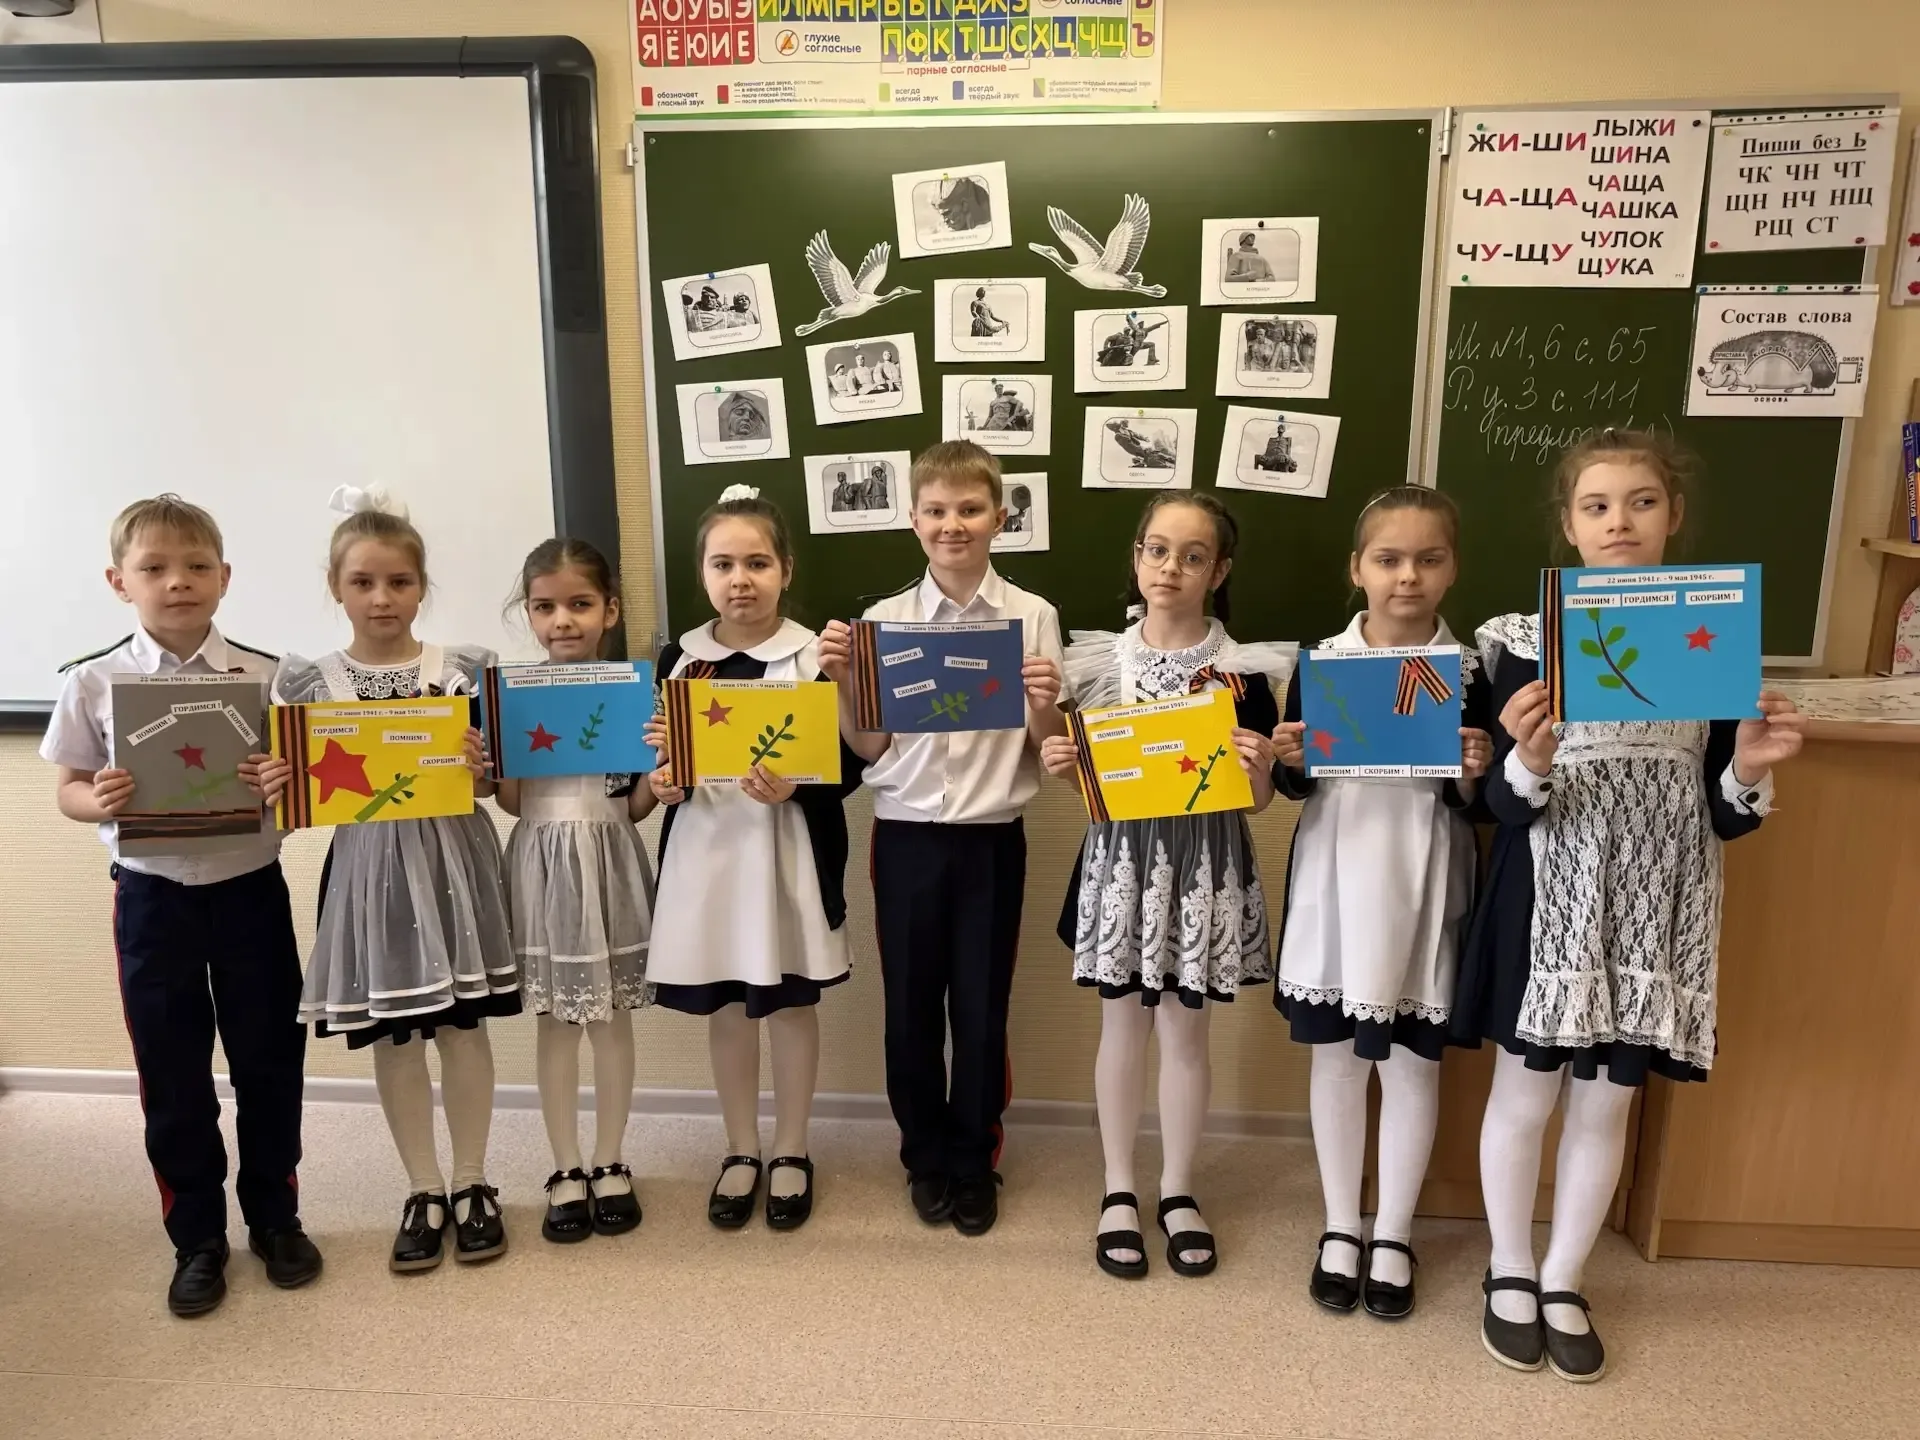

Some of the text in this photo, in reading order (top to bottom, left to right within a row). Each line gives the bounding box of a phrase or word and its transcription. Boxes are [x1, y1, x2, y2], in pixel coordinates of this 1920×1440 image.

[804, 34, 840, 44] глухие
[804, 44, 861, 53] согласные
[907, 64, 1007, 77] парные согласные
[657, 98, 687, 106] гласный
[968, 92, 1001, 101] твёрдый
[1592, 119, 1676, 137] ЛЫЖИ
[1468, 133, 1587, 152] ЖИ-ШИ
[1741, 138, 1800, 154] Пиши
[1813, 135, 1841, 150] без
[1590, 146, 1670, 163] ШИНА
[1739, 161, 1866, 184] ЧК ЧН ЧТ
[1588, 174, 1664, 195] ЧАЩА
[1462, 188, 1578, 209] ЧА-ЩА
[1725, 187, 1873, 214] ЩН НЧ НЩ
[1581, 202, 1678, 219] ЧАШКА
[1754, 216, 1839, 238] РЩ СТ
[1581, 231, 1664, 248] ЧУЛОК
[1457, 243, 1573, 265] ЧУ-ЩУ
[1578, 258, 1654, 278] ЩУКА
[1721, 309, 1852, 324] Состав слова
[1544, 324, 1564, 360] 6
[1607, 326, 1656, 364] 65
[1583, 378, 1640, 410] 111
